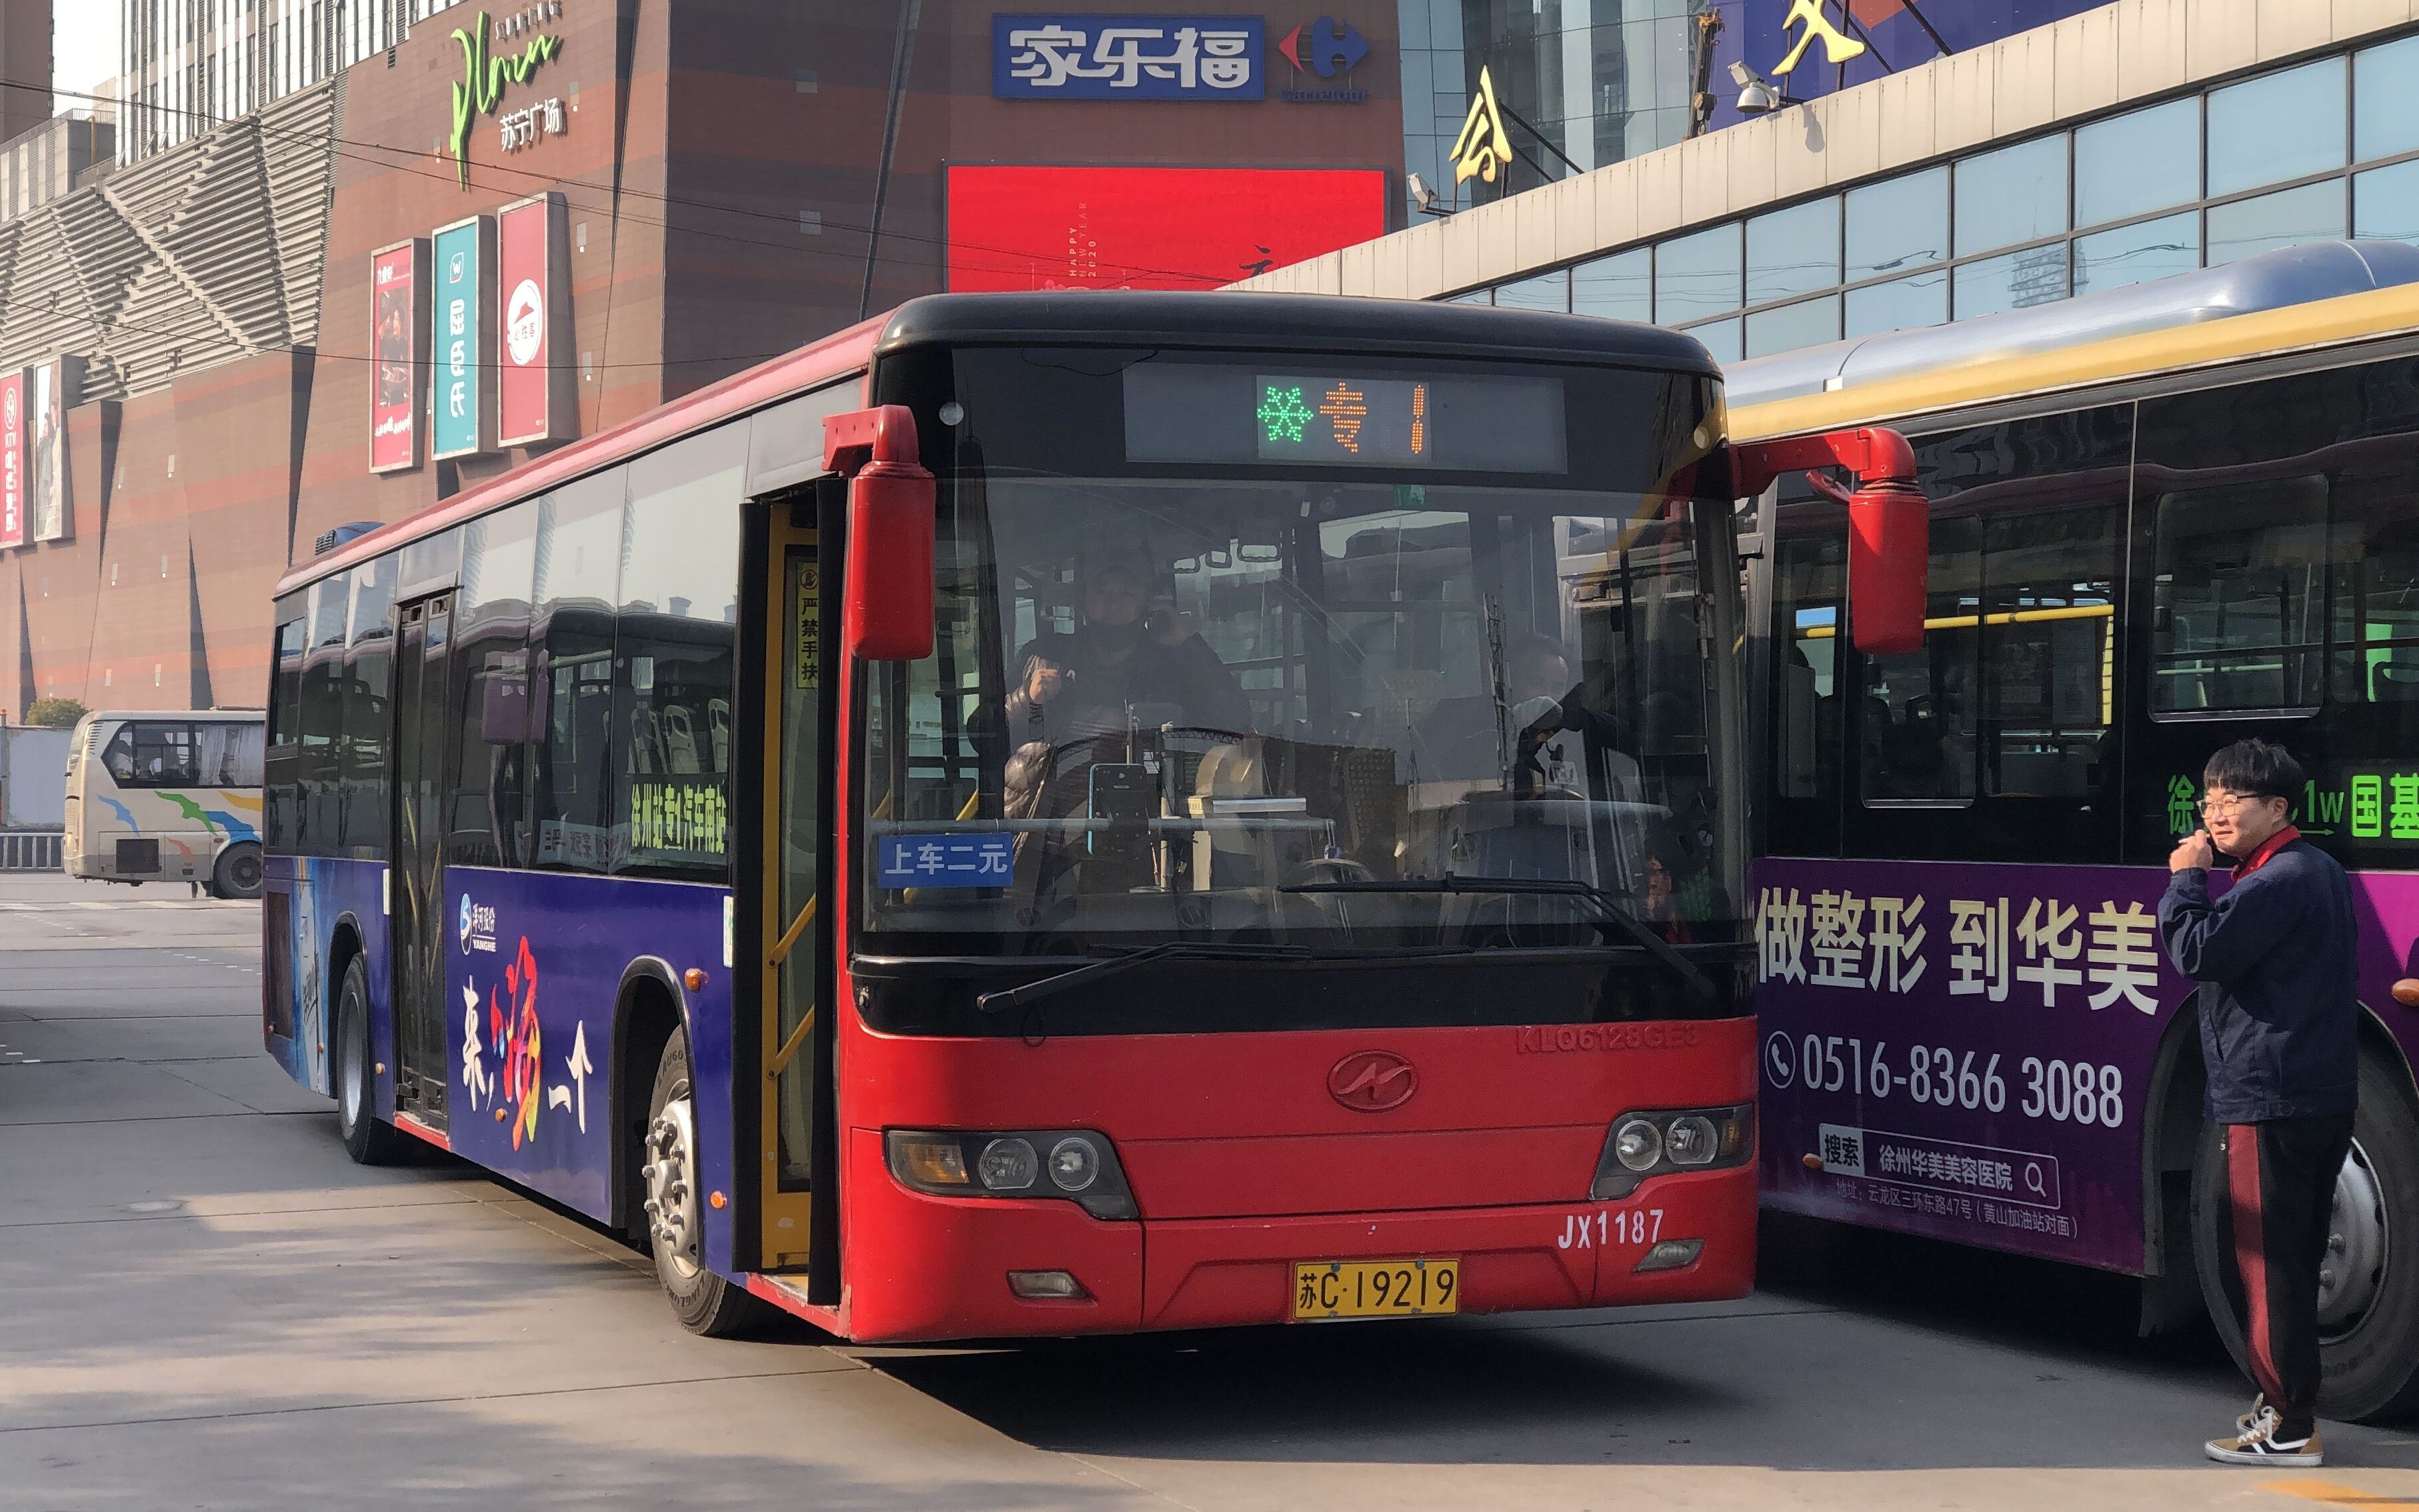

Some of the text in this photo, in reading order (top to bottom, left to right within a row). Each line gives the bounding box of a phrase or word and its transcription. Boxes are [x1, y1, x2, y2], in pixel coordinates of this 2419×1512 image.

[495, 0, 555, 40] SUNING
[1009, 25, 1250, 89] 家乐福
[499, 97, 561, 153] 苏宁广场
[1069, 227, 1077, 277] HAPPY
[1078, 203, 1087, 277] NEW YEAR
[1087, 241, 1097, 277] 2020
[450, 299, 465, 418] 屈臣氏
[1320, 381, 1367, 453] 专
[801, 598, 818, 680] 严禁手扶
[2168, 774, 2196, 835] 徐
[885, 842, 1008, 876] 上车二元
[472, 939, 497, 953] YANGHE
[1754, 887, 2160, 1016] 做整形 到华美
[1803, 1033, 2124, 1128] 0516-8366 3088
[1824, 1133, 1860, 1167] 搜索
[1879, 1143, 2014, 1192] 徐州华美美容医院
[1558, 1209, 1664, 1250] JX1187
[1300, 1269, 1455, 1310] 苏C·19219
